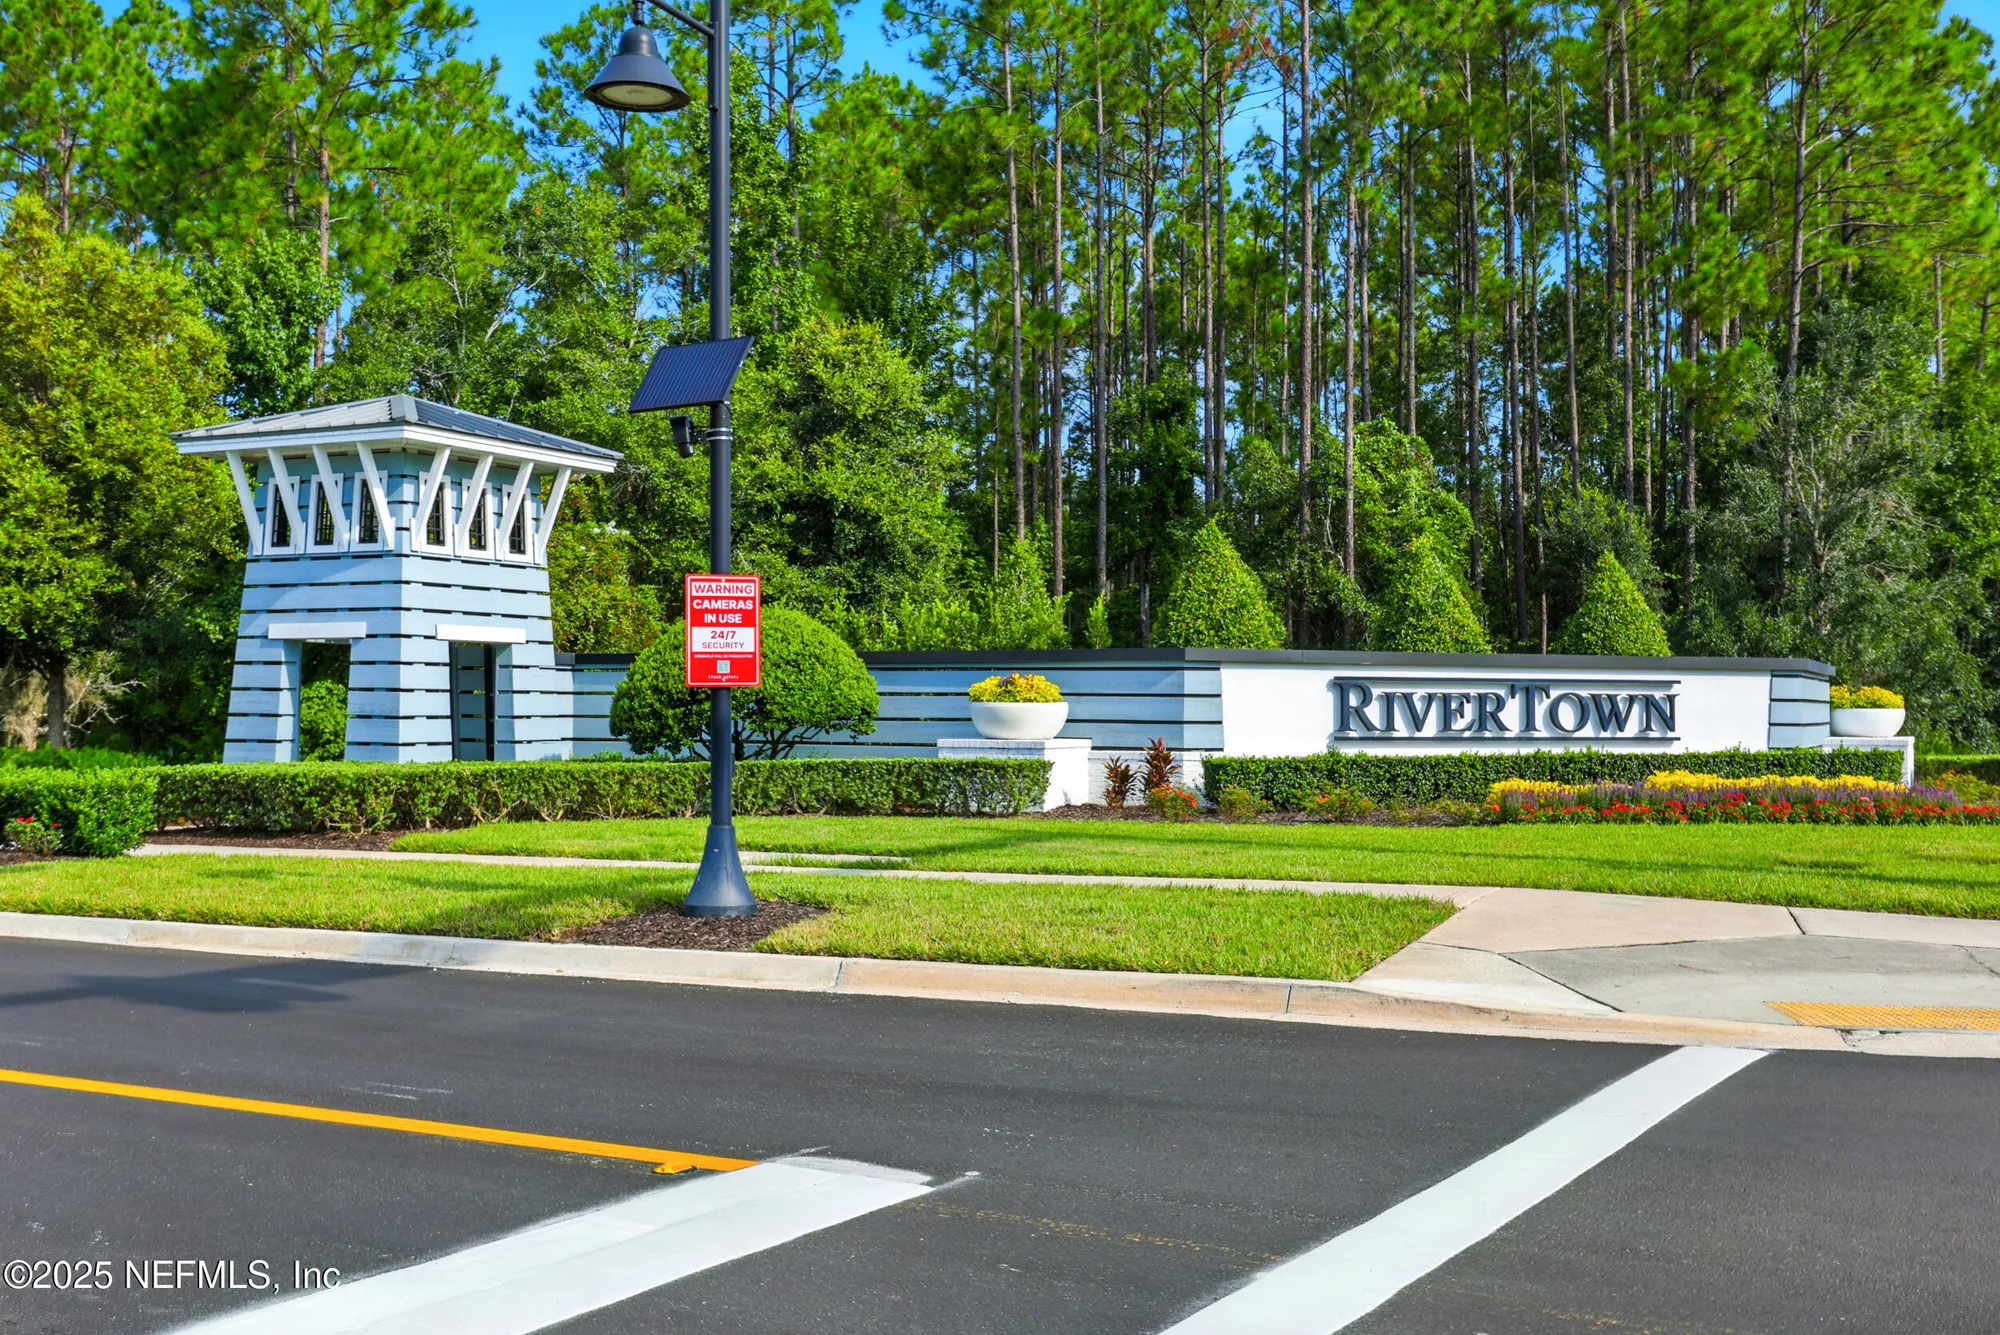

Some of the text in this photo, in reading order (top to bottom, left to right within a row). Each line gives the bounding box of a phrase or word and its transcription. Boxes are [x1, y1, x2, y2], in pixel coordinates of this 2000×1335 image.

[694, 584, 753, 594] WARNING
[693, 599, 754, 610] CAMERAS
[704, 613, 743, 623] IN USE
[710, 630, 737, 640] 24/7
